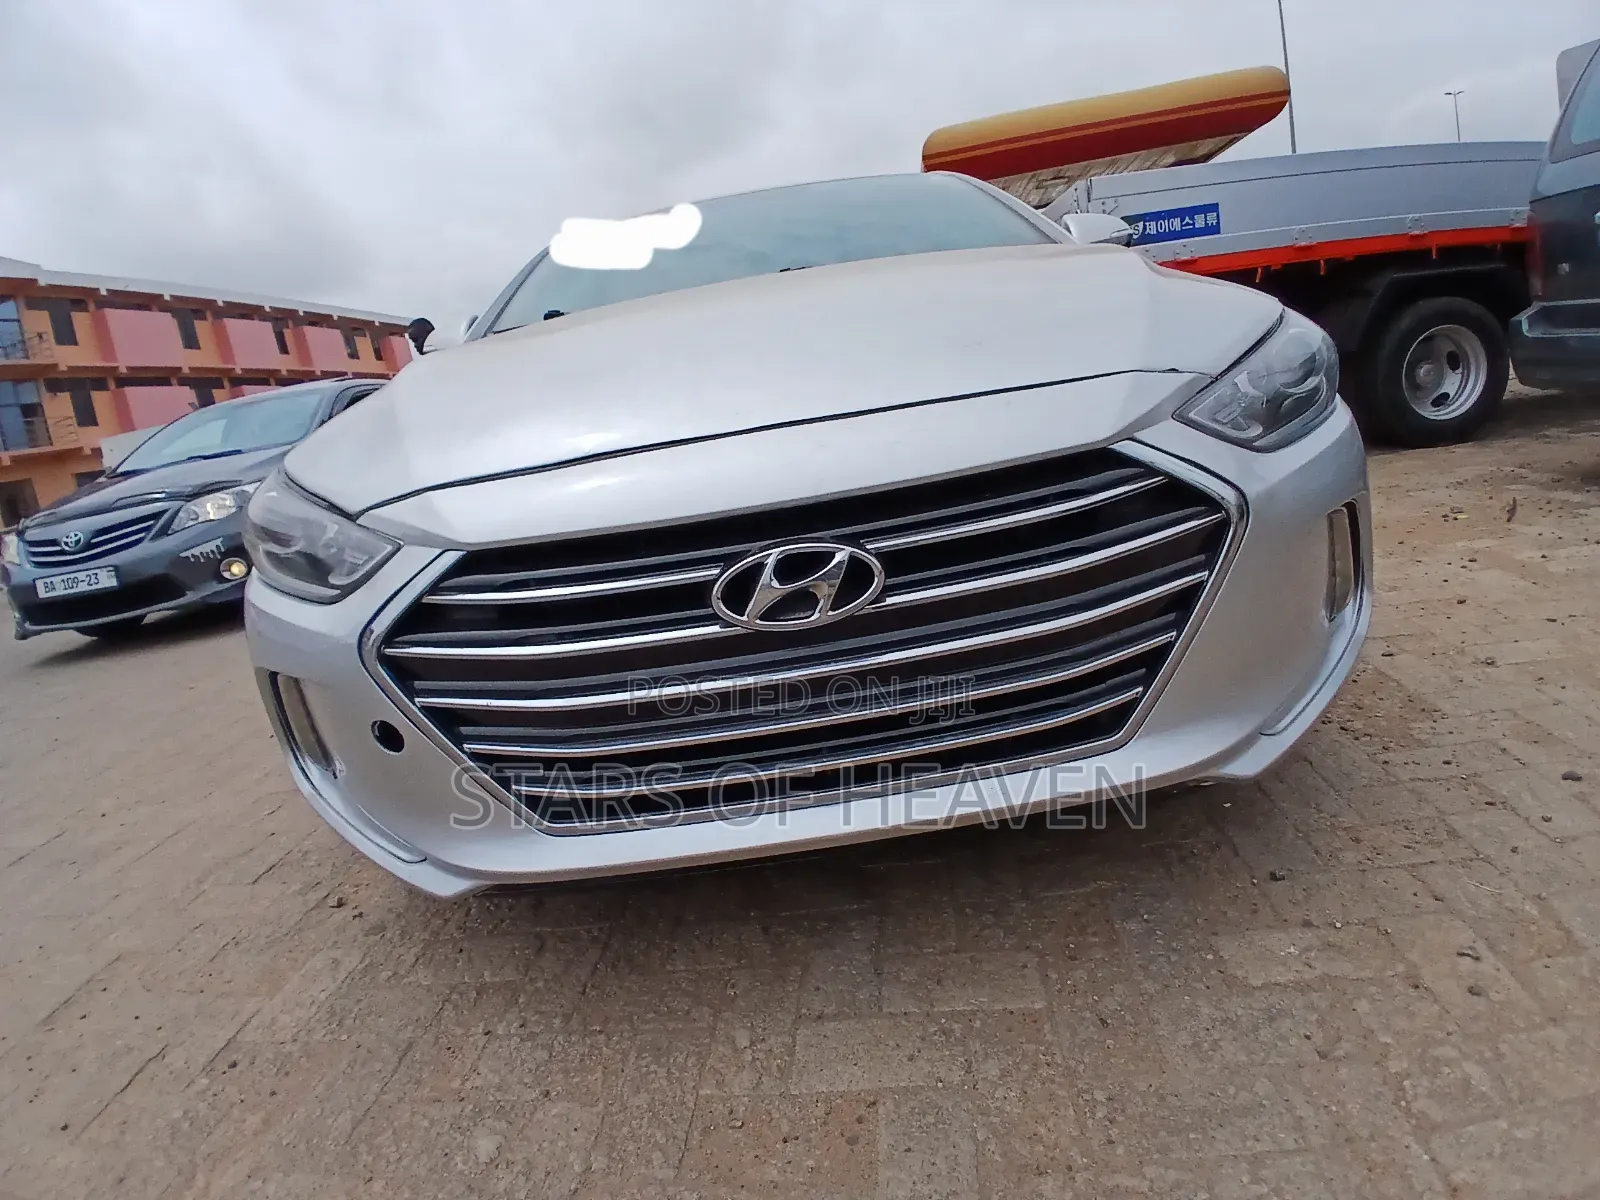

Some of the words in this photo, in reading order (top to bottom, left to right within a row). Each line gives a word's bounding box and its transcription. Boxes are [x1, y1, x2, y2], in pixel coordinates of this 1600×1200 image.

[1144, 212, 1219, 236] 제이에스물류
[43, 580, 57, 594] BA
[61, 572, 100, 591] 109-23
